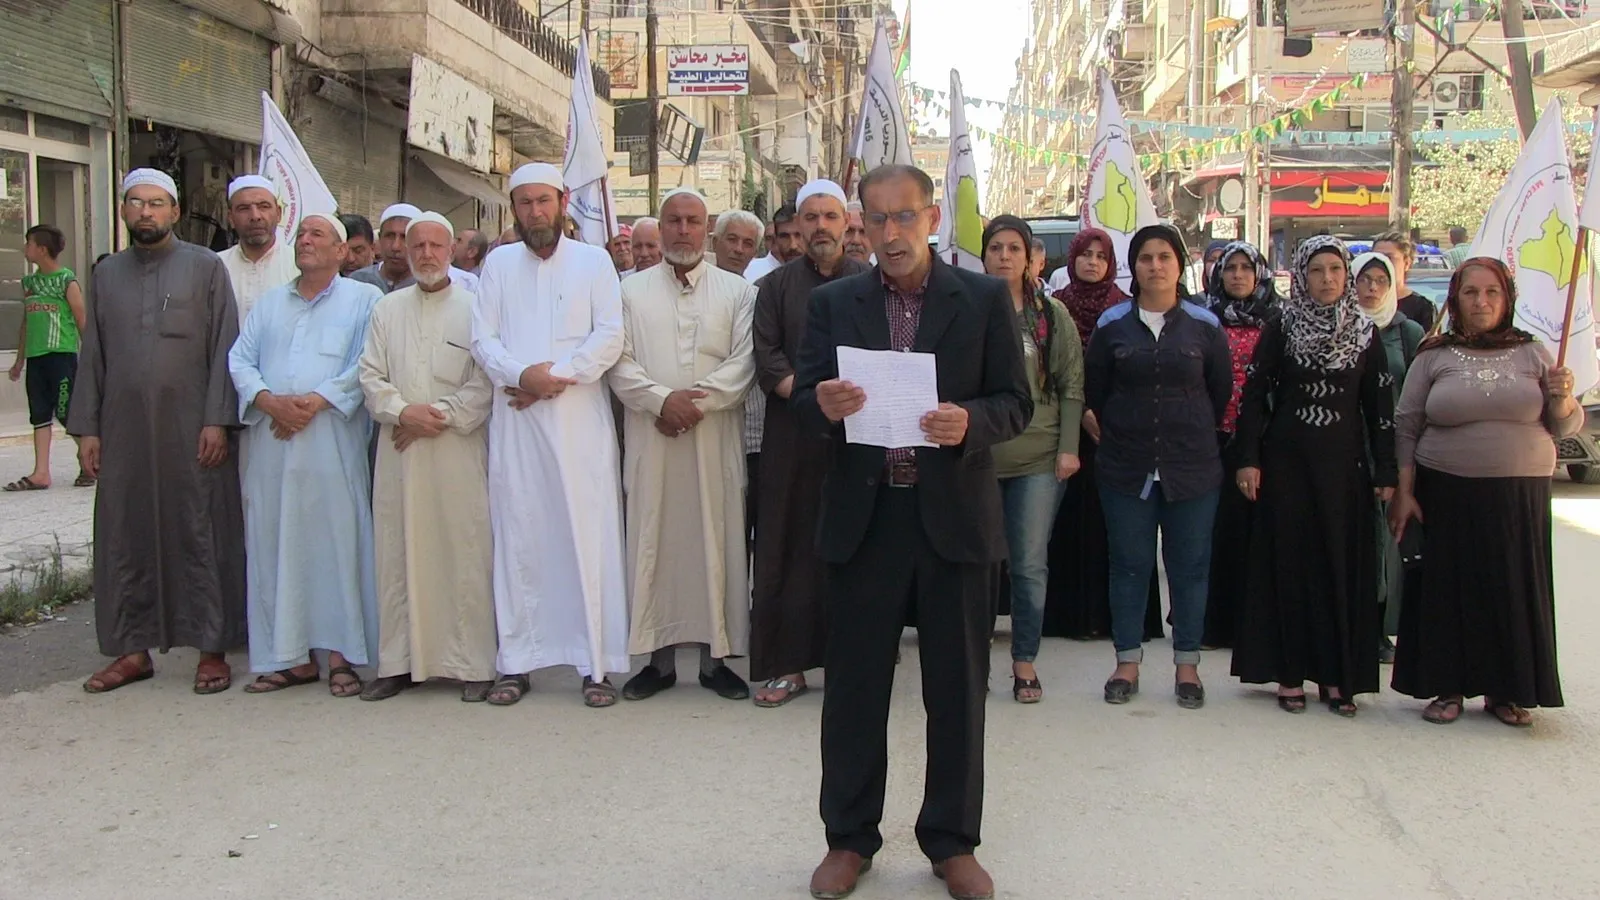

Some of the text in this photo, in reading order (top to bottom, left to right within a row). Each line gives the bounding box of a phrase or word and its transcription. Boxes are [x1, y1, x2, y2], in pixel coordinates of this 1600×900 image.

[670, 47, 746, 68] مخبر محاسن
[670, 71, 747, 83] للتحاليل الطبية
